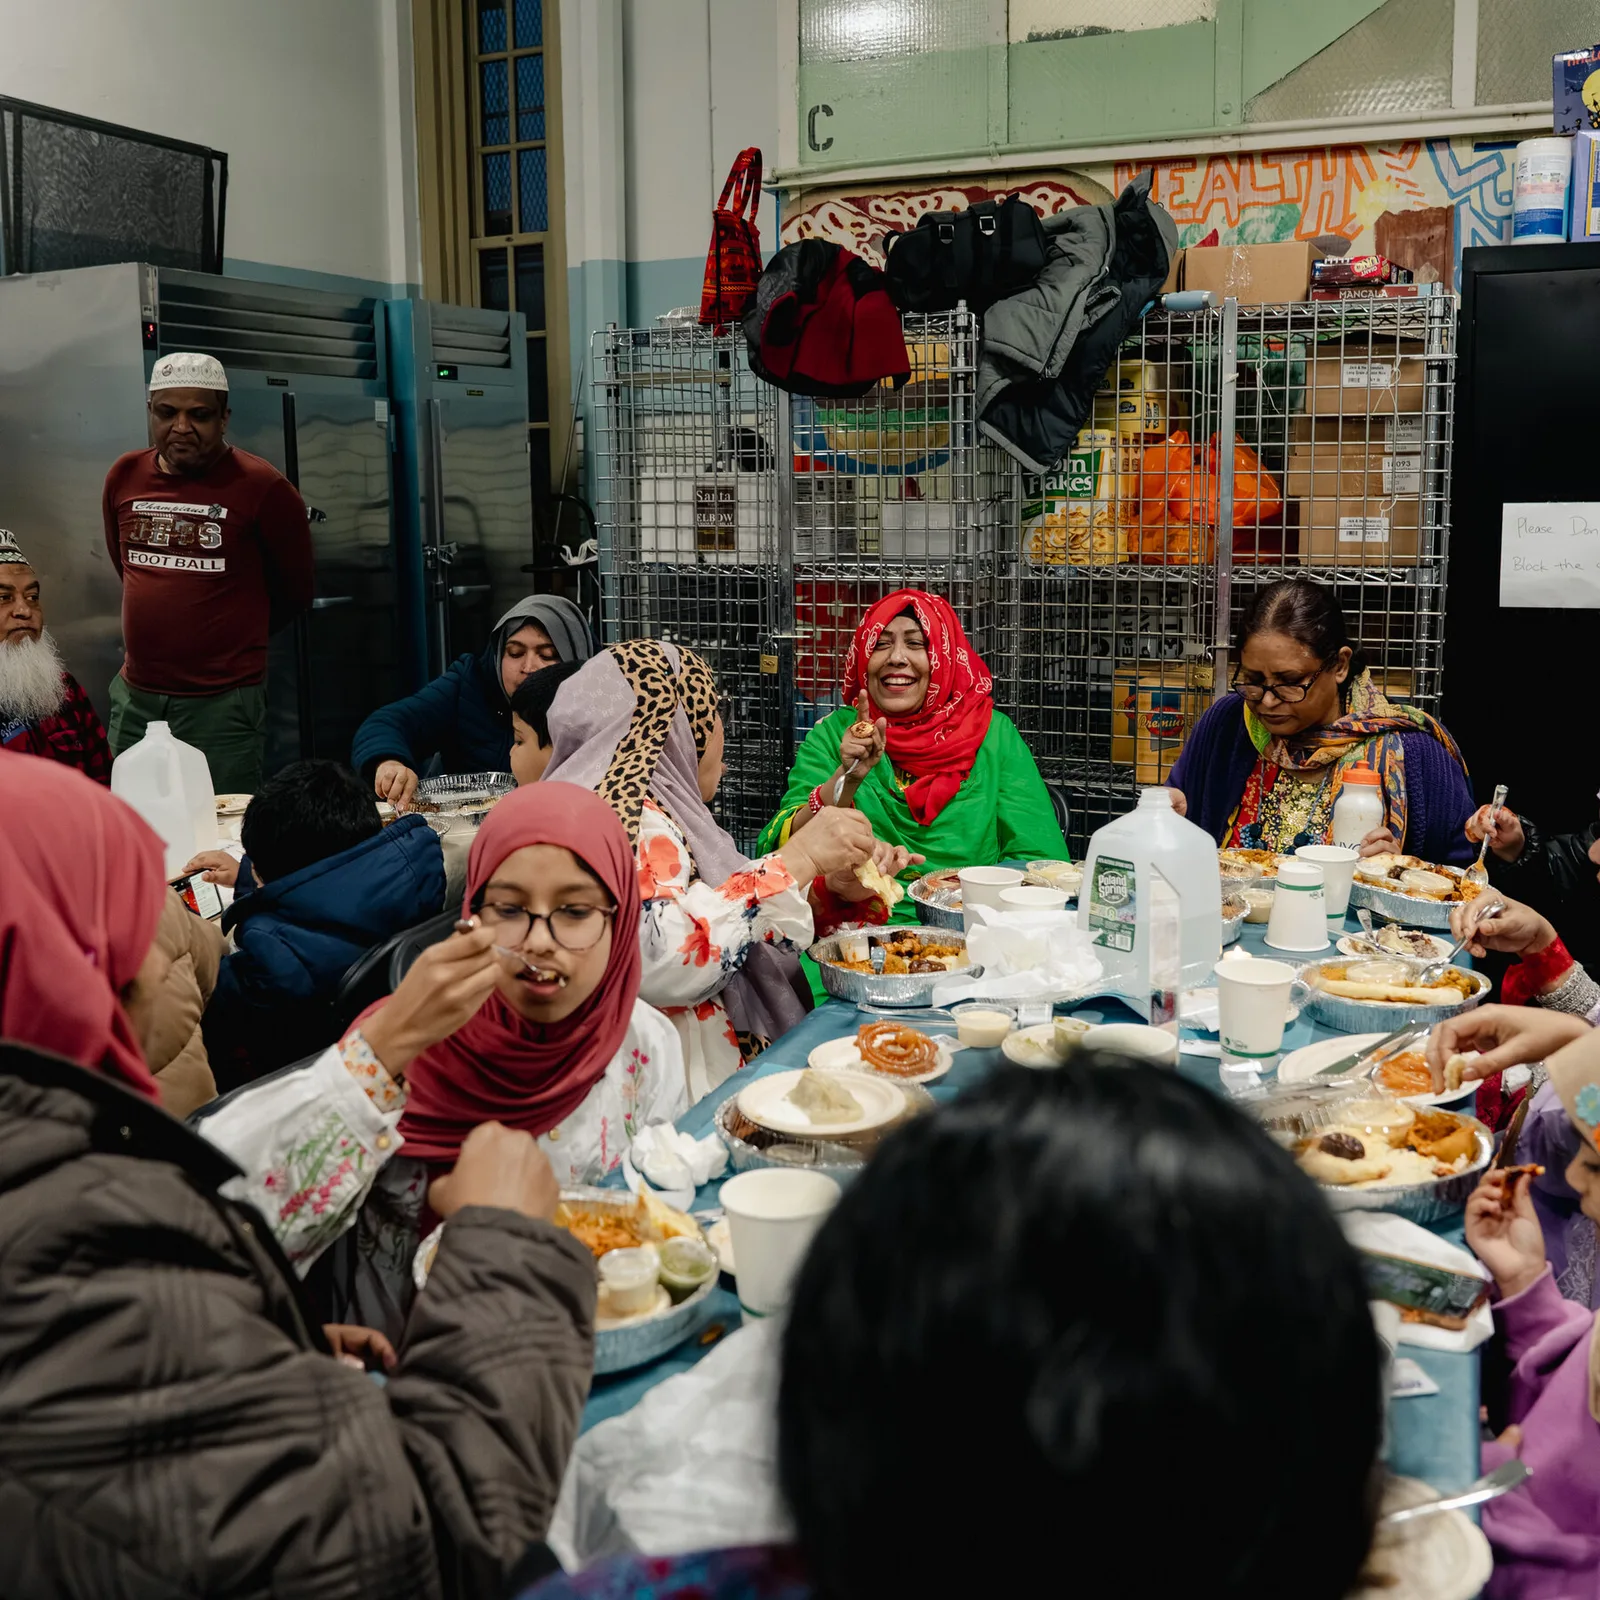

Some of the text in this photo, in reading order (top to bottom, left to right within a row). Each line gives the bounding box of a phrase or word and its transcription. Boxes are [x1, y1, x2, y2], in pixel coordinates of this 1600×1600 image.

[807, 104, 834, 151] C
[1339, 289, 1388, 299] MANCALA
[1517, 516, 1556, 538] Please
[130, 552, 222, 570] FOOT BALL
[1512, 556, 1549, 572] Block
[1554, 559, 1585, 572] the
[1098, 874, 1127, 887] Poland
[1099, 886, 1127, 898] Spring
